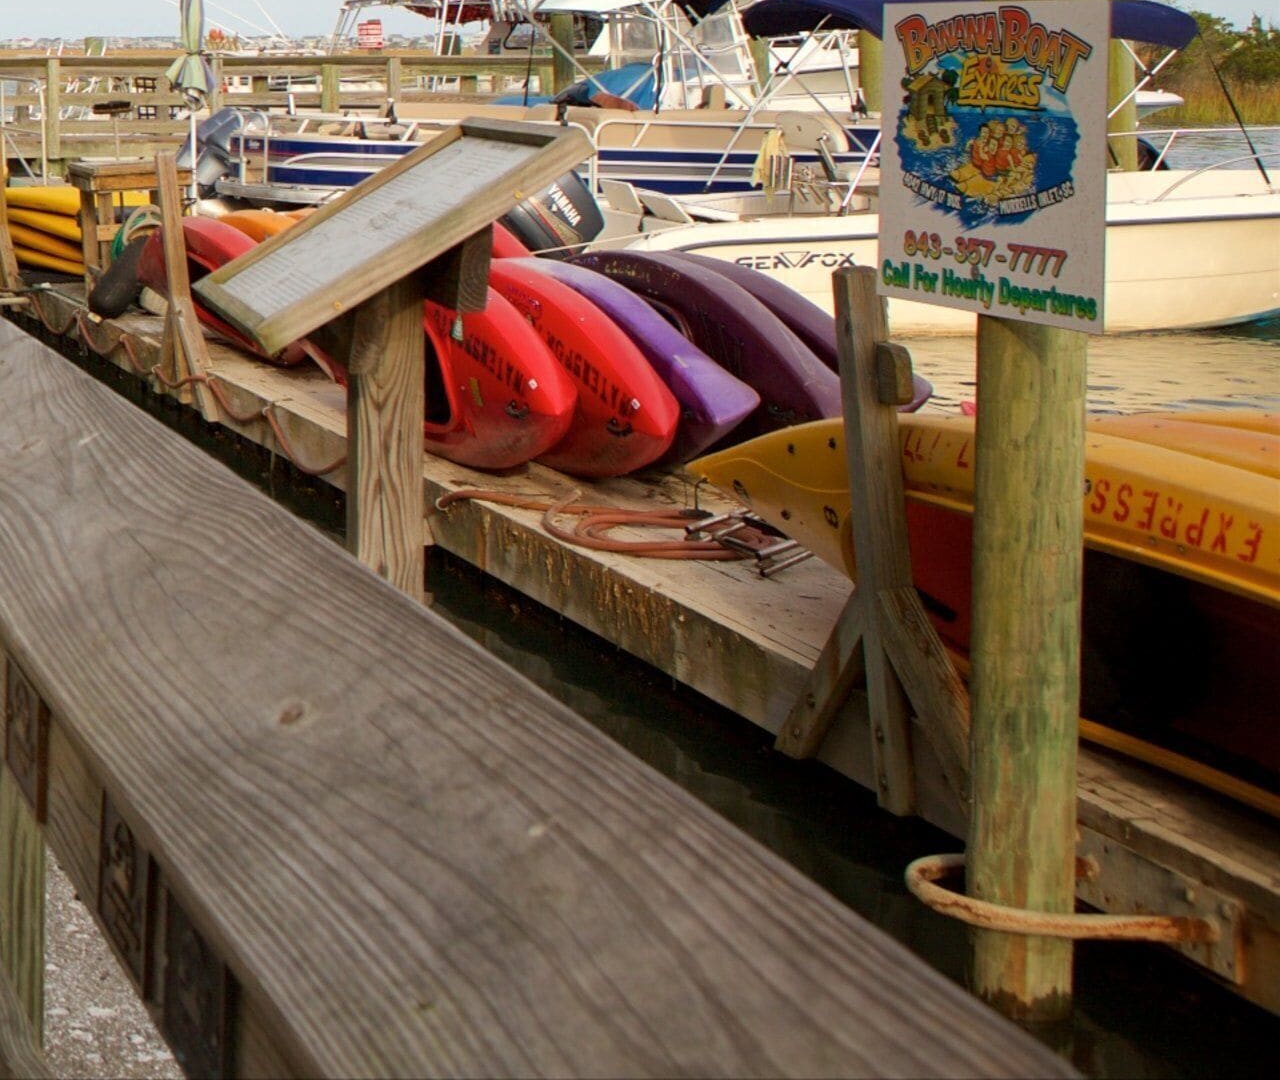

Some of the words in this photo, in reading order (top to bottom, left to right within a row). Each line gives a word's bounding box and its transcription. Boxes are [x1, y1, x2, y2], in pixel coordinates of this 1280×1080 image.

[896, 14, 1001, 75] BANANA
[999, 5, 1092, 94] BOAT
[957, 56, 1042, 107] Express
[547, 183, 582, 227] YAMAHA
[903, 229, 1068, 278] 843-357-7777
[882, 258, 911, 290] Call
[913, 263, 938, 294] For
[941, 266, 994, 310] Hourly
[998, 275, 1098, 322] Departures
[1091, 478, 1263, 563] EXPRESS
